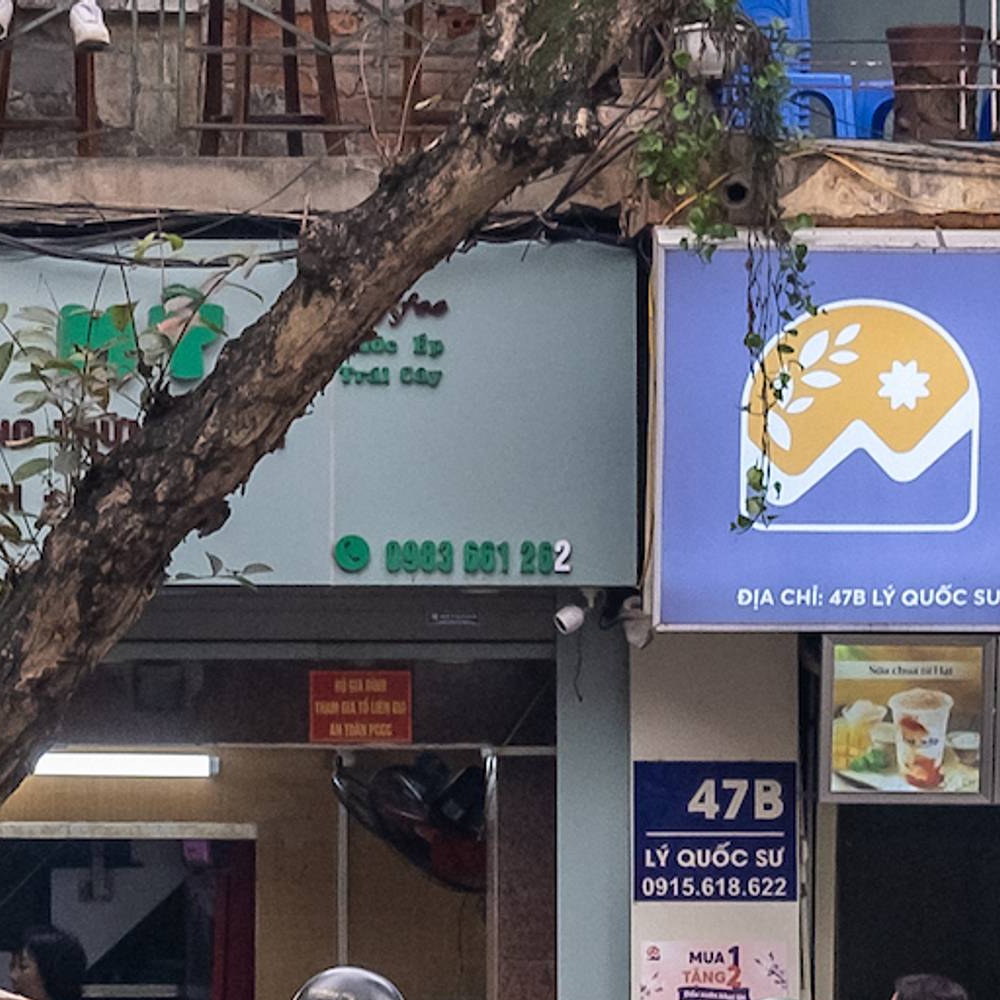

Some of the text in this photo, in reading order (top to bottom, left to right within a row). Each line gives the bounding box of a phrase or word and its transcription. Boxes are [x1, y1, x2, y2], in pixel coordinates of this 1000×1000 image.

[386, 539, 573, 575] 0983 661 262
[737, 588, 774, 611] ĐỊA
[780, 585, 823, 607] CHỈ:
[829, 589, 866, 606] 47B
[872, 585, 896, 607] LÝ
[901, 585, 967, 607] QUỐC
[687, 778, 785, 821] 47B
[645, 841, 785, 868] LÝ QUỐC SƯ
[642, 877, 787, 898] 0915.618.622
[688, 946, 740, 967] MUA 1
[726, 965, 742, 989] 2
